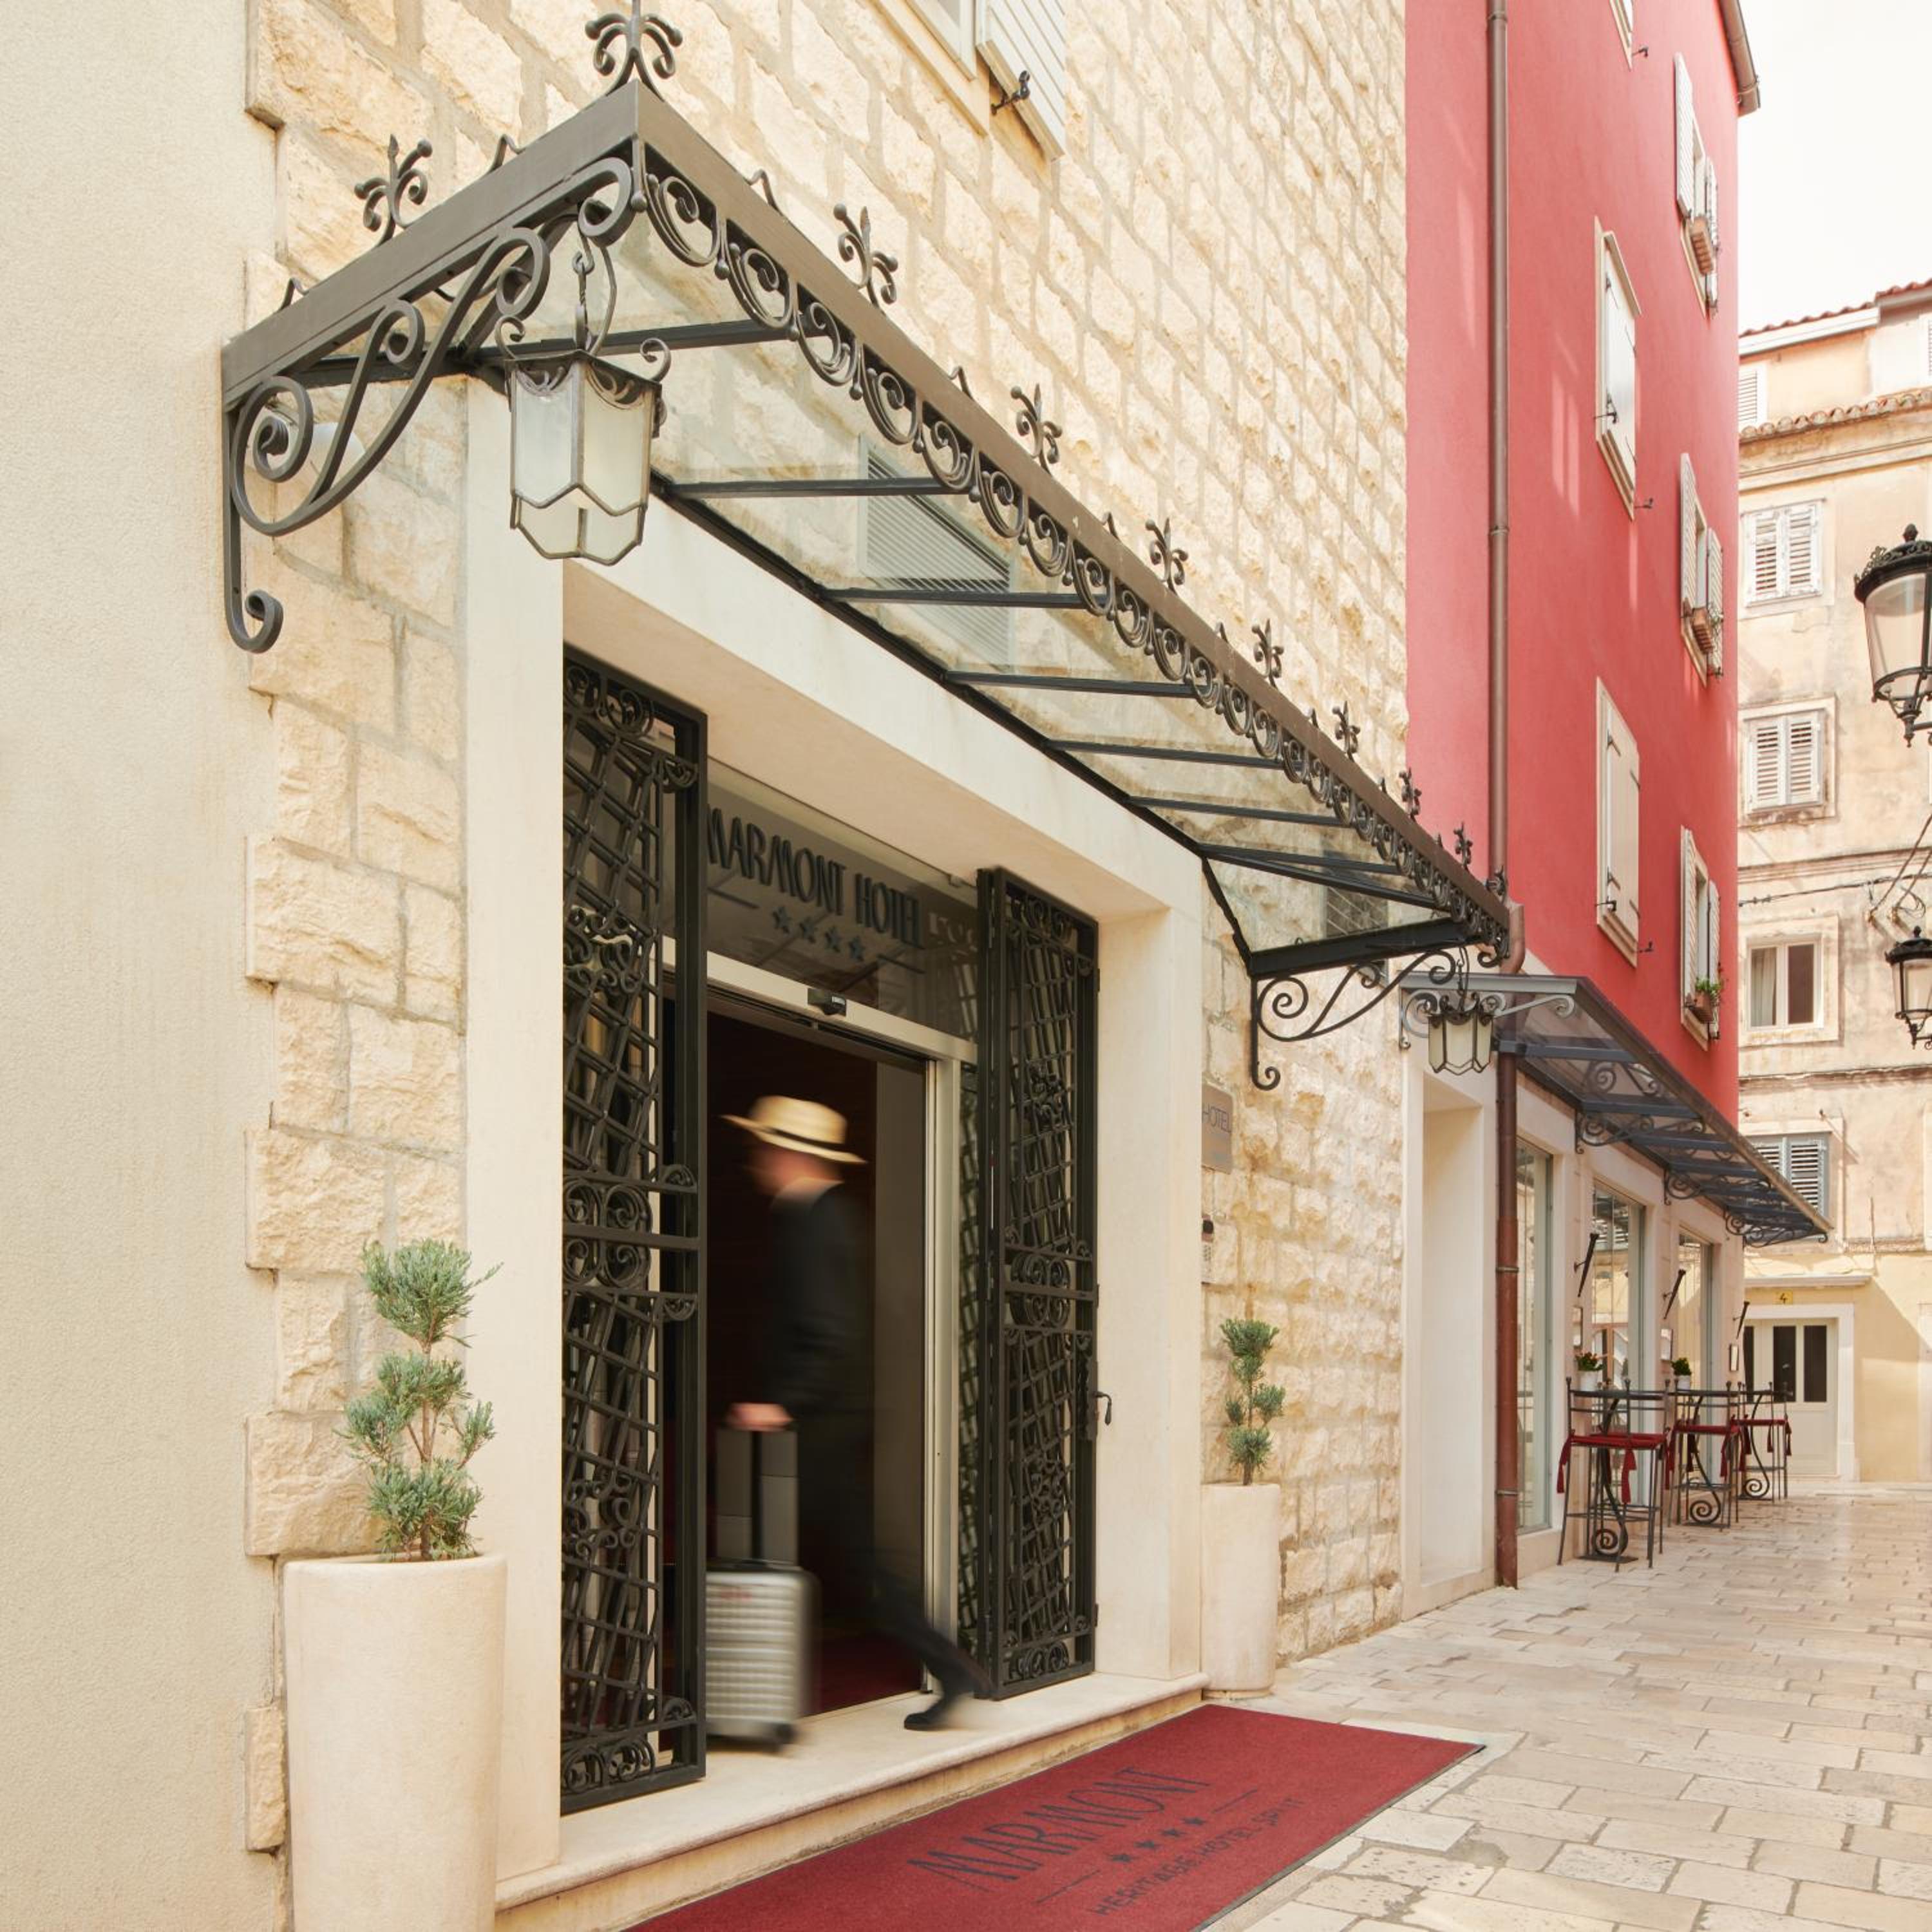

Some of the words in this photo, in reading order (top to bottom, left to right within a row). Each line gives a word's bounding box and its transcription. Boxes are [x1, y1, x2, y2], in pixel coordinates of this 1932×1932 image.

[706, 804, 846, 916] MARMONT
[855, 873, 926, 949] HOTEL
[907, 1766, 1210, 1893] MARMONT
